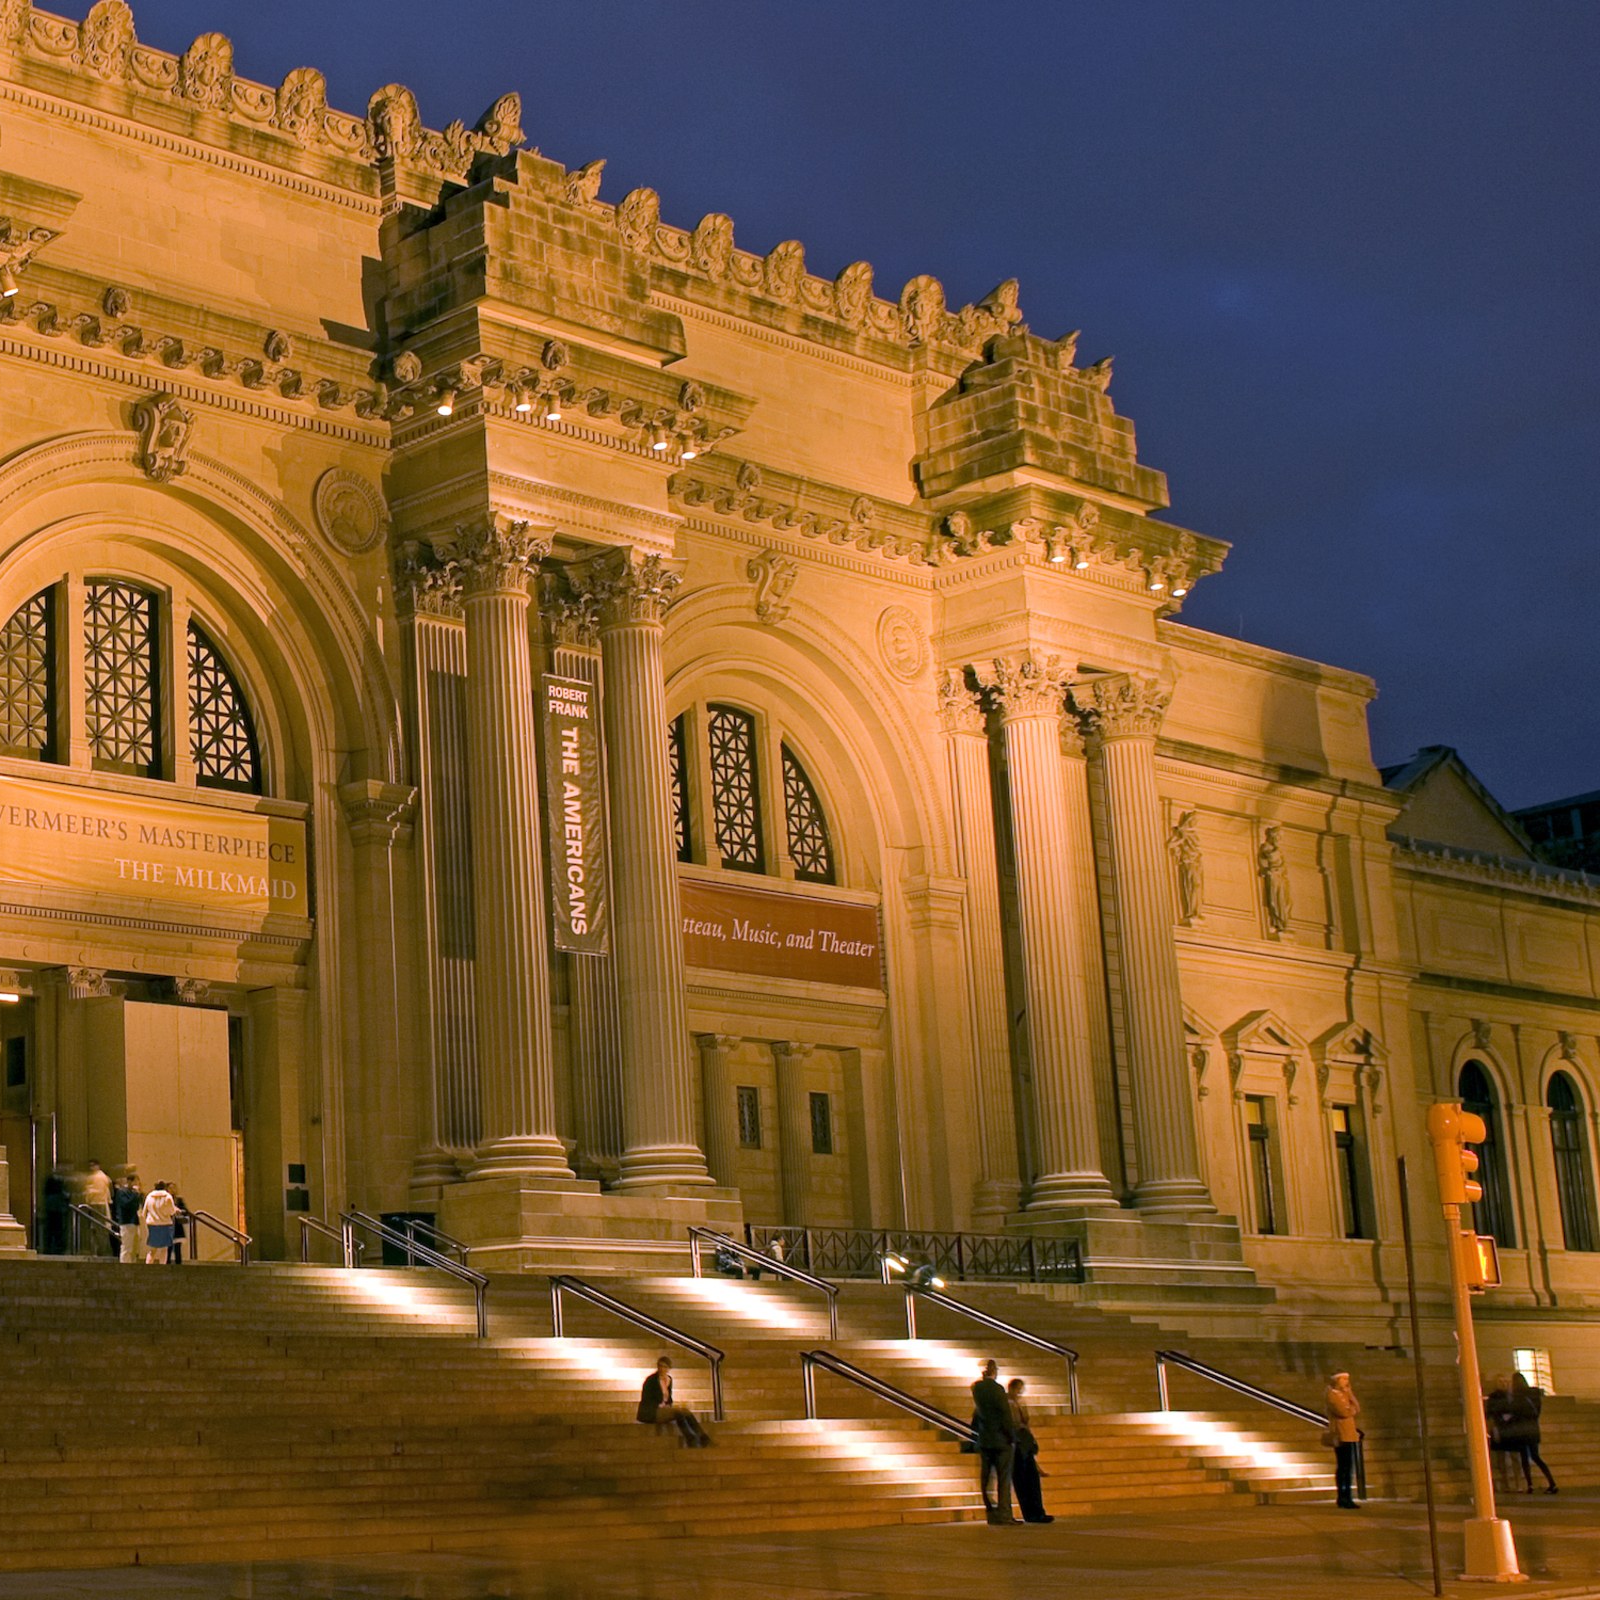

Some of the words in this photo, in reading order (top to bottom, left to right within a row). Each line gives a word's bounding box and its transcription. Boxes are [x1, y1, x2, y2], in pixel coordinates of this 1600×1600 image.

[548, 684, 588, 703] ROBERT
[548, 700, 589, 720] FRANK
[561, 726, 580, 775] THE
[138, 823, 297, 865] MASTERPIECE
[563, 780, 588, 936] AMERICANS
[114, 857, 165, 884] THE
[174, 866, 298, 901] MILKMAID
[731, 917, 782, 949] Music,
[785, 928, 815, 951] and
[817, 930, 876, 958] Theater
